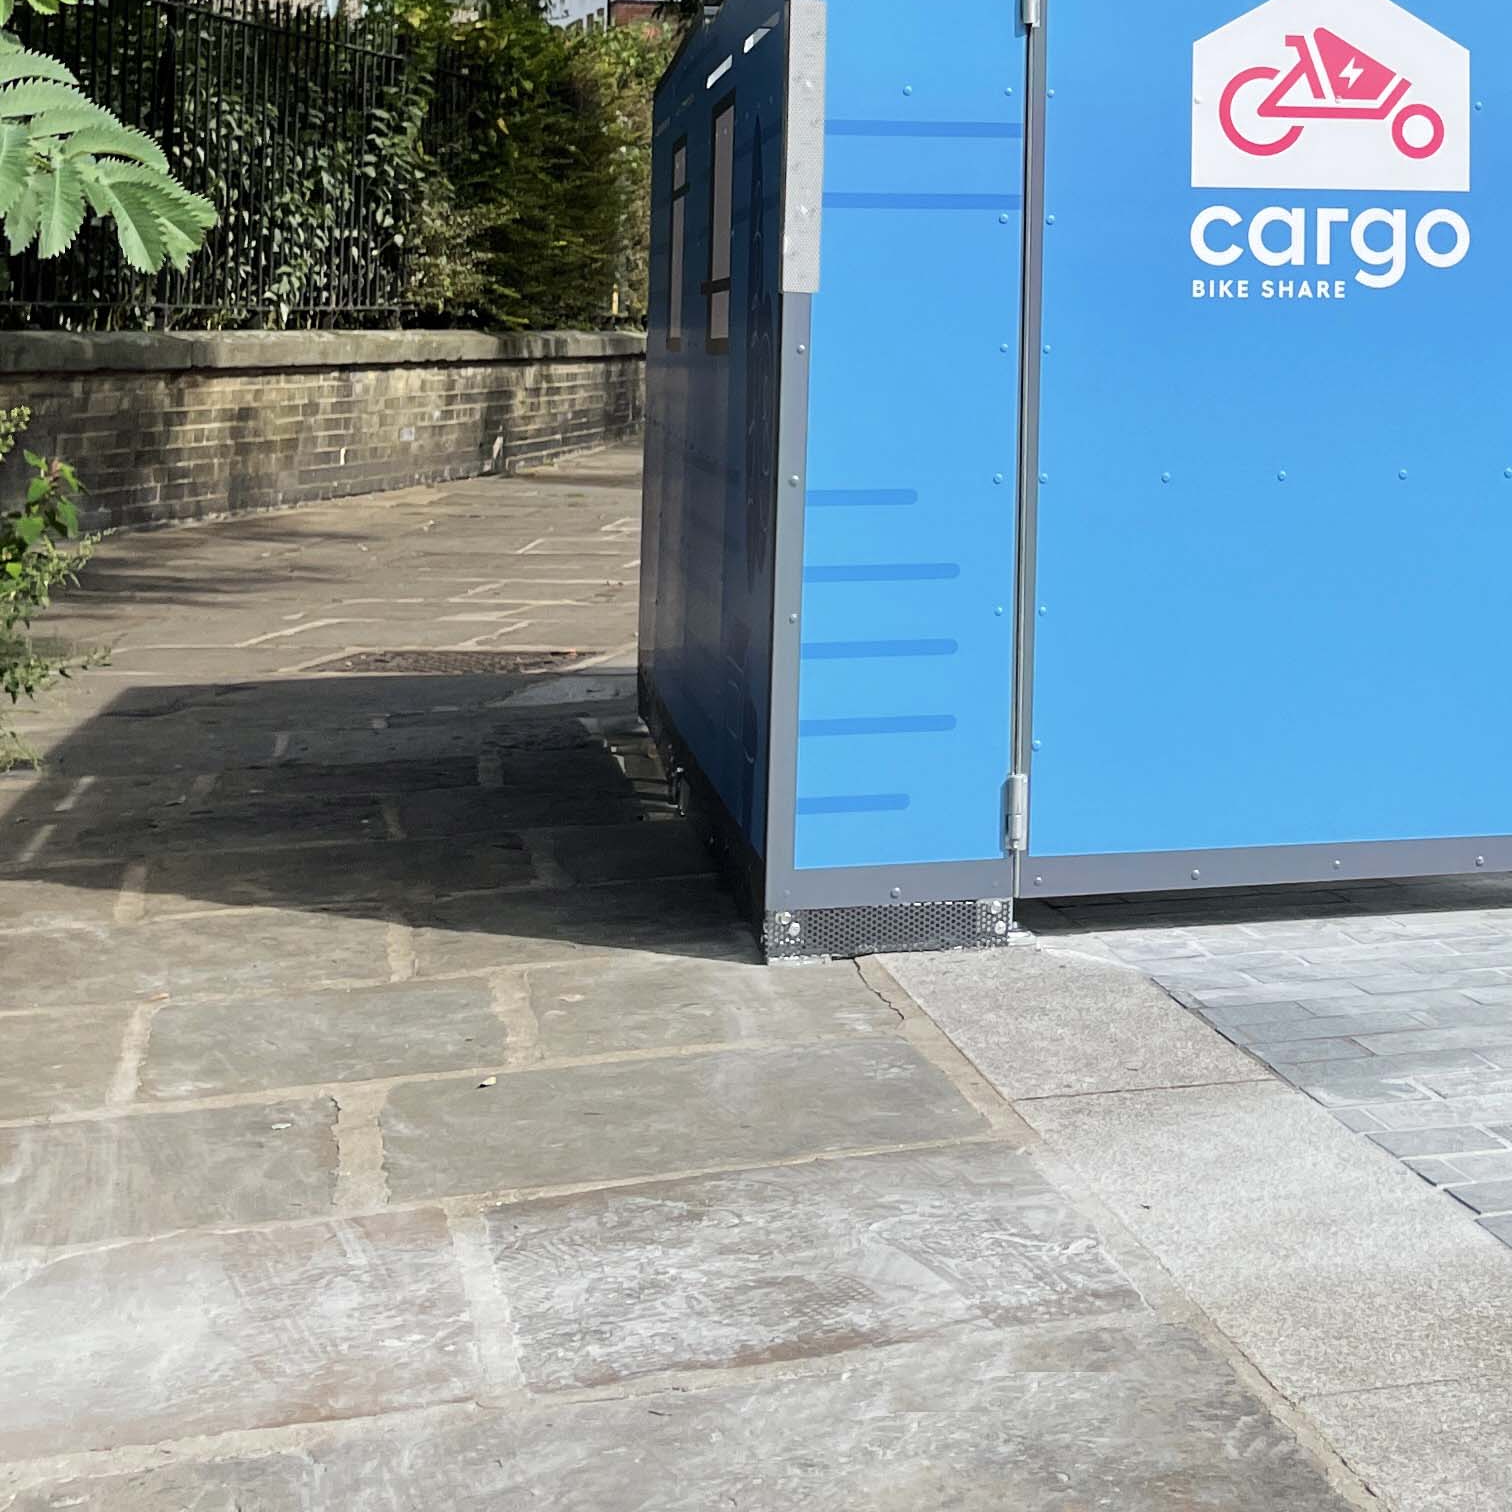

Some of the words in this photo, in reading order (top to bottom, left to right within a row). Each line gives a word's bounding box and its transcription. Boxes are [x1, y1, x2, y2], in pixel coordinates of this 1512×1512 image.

[1190, 205, 1471, 289] cargo
[1192, 279, 1249, 298] BIKE
[1261, 280, 1345, 299] SHARE
